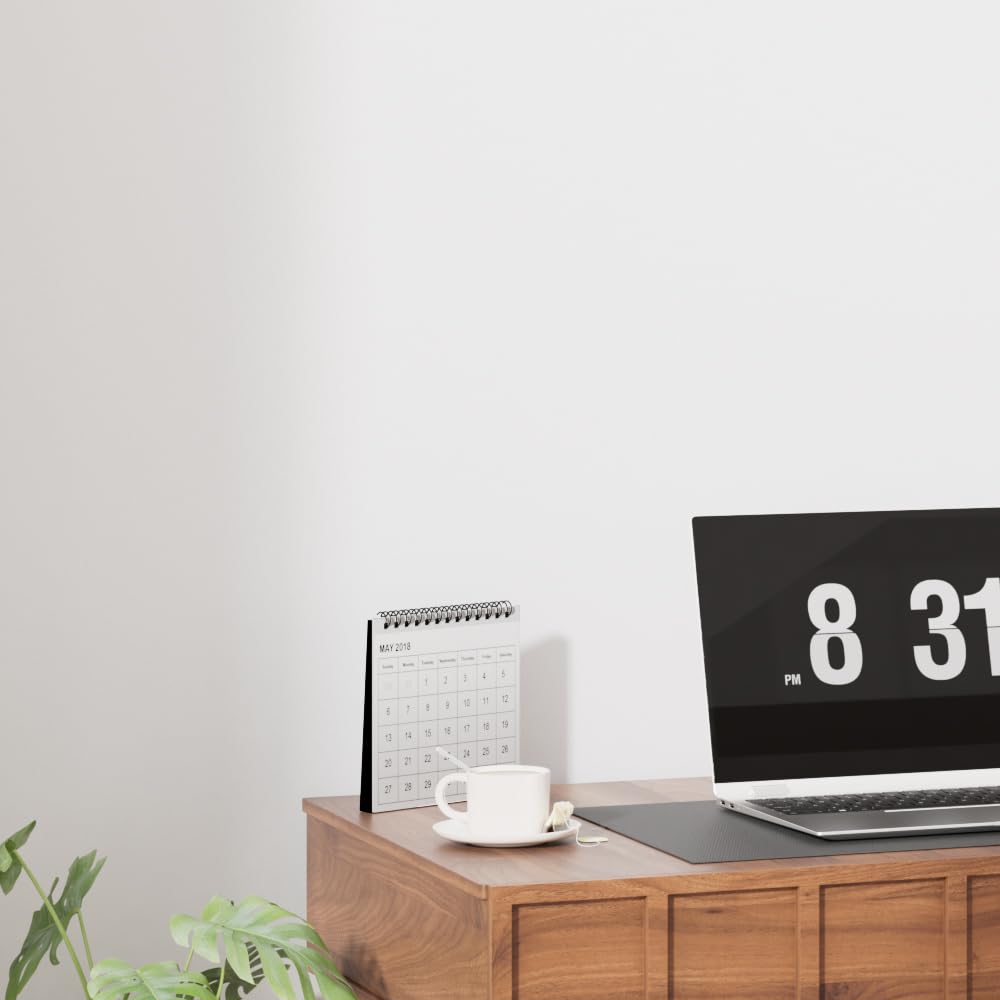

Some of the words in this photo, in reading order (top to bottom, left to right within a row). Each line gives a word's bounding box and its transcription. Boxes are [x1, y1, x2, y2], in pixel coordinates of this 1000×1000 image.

[784, 673, 801, 686] PM
[807, 582, 863, 685] 8
[380, 644, 393, 653] MAY
[395, 641, 411, 652] 2018
[482, 696, 489, 705] 11
[502, 694, 509, 704] 12
[463, 723, 471, 733] 17
[502, 719, 509, 729] 19
[424, 753, 432, 763] 22
[463, 748, 471, 758] 24
[384, 784, 392, 794] 27
[404, 781, 412, 792] 28
[424, 779, 432, 789] 29
